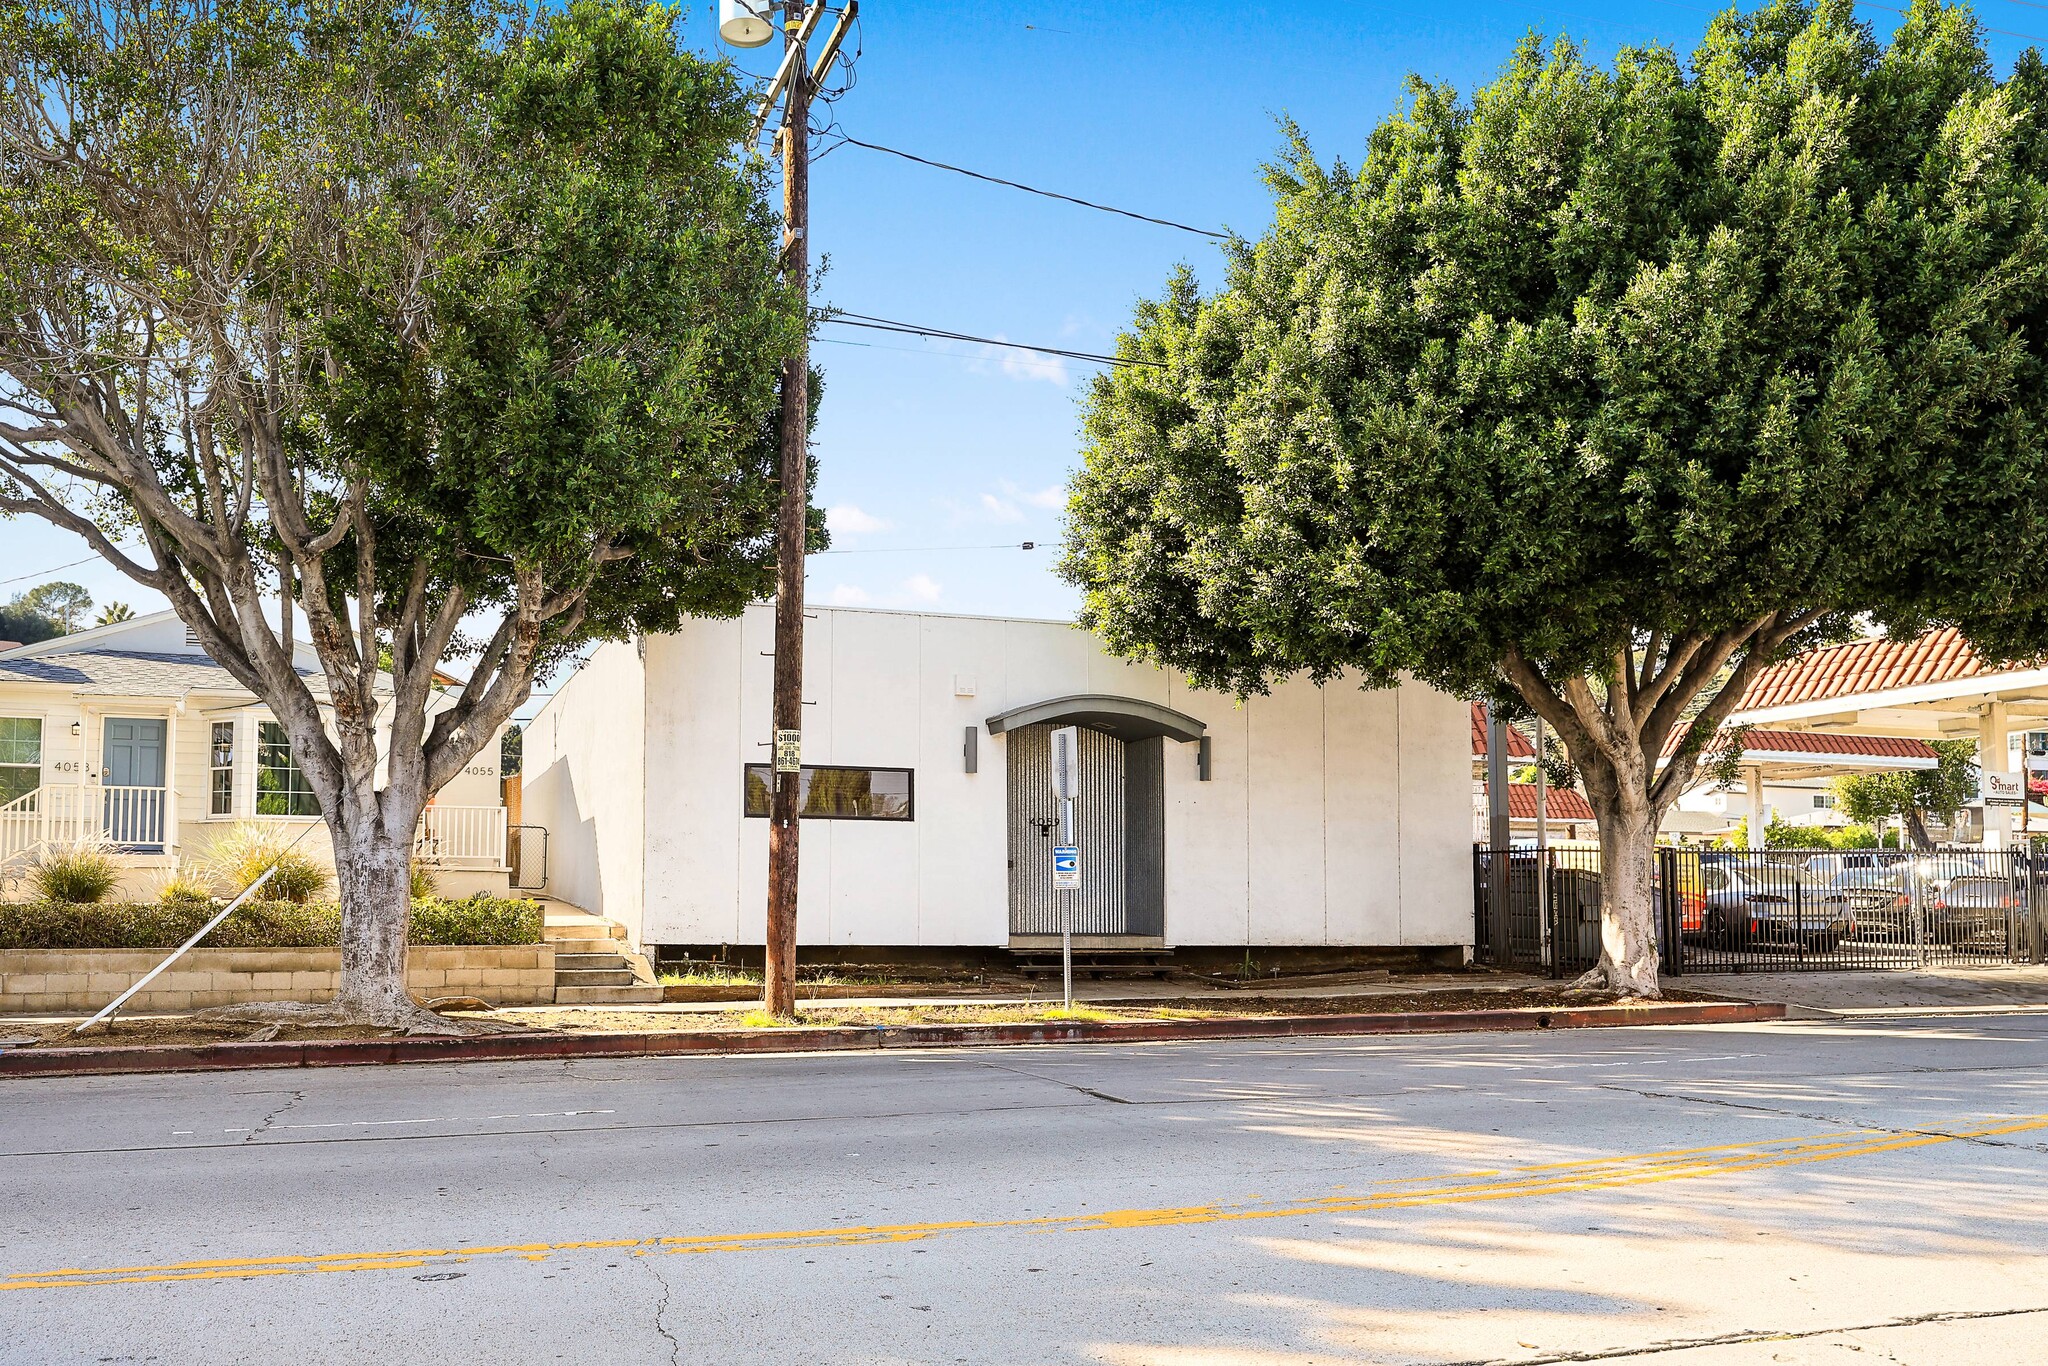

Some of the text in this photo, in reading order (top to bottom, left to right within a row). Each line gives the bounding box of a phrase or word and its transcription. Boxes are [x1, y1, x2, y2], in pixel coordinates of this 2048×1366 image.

[465, 766, 494, 776] 4055
[1990, 775, 2019, 791] Smart
[1030, 818, 1060, 827] 4059
